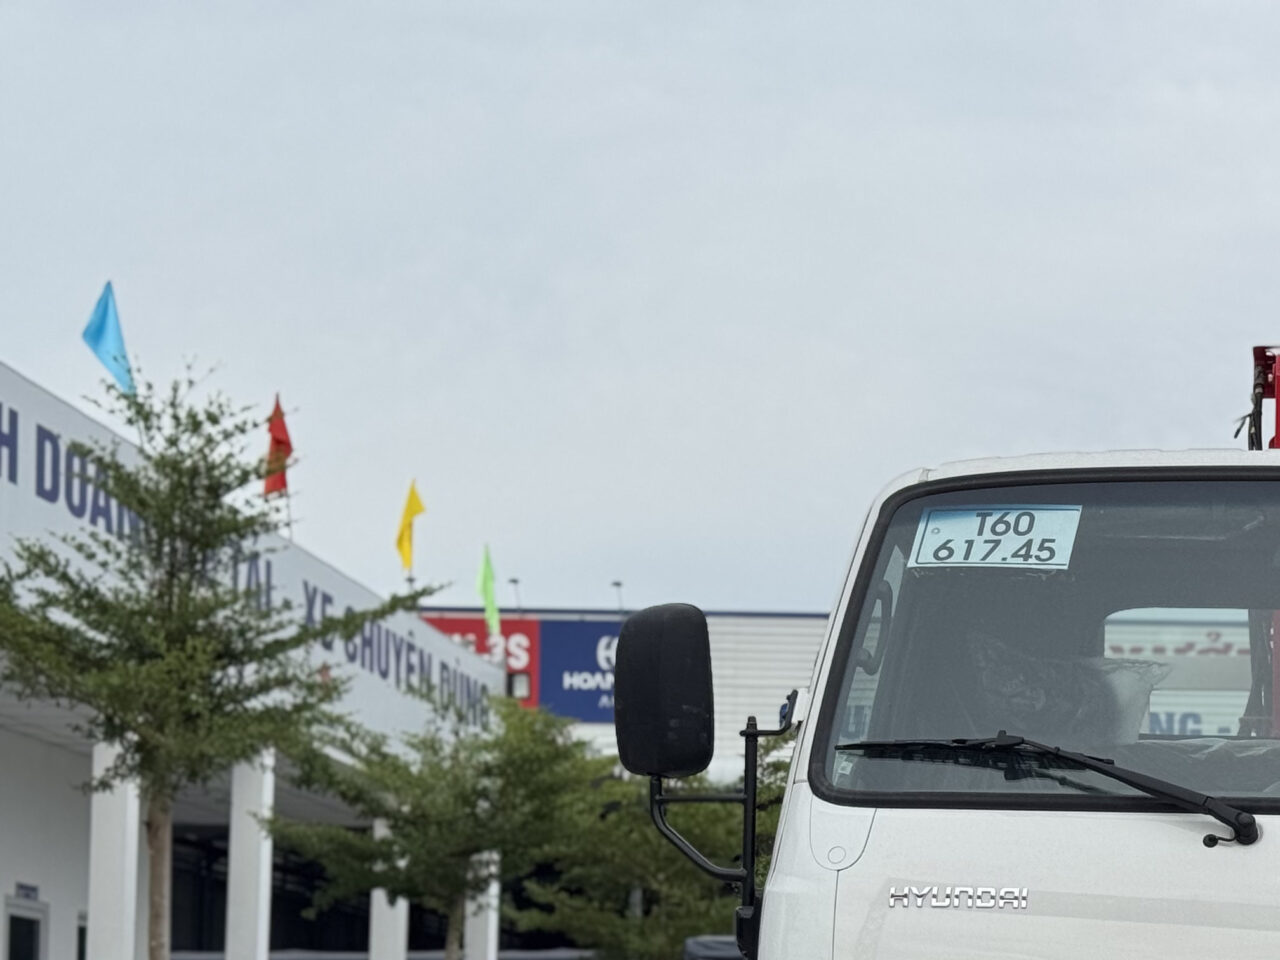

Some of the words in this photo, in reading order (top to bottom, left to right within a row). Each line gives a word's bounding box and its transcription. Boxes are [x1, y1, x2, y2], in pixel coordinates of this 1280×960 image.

[976, 511, 1035, 536] T60
[932, 538, 1056, 562] 617.45
[562, 671, 614, 690] HOAN
[888, 886, 1029, 909] HYUNDAI
